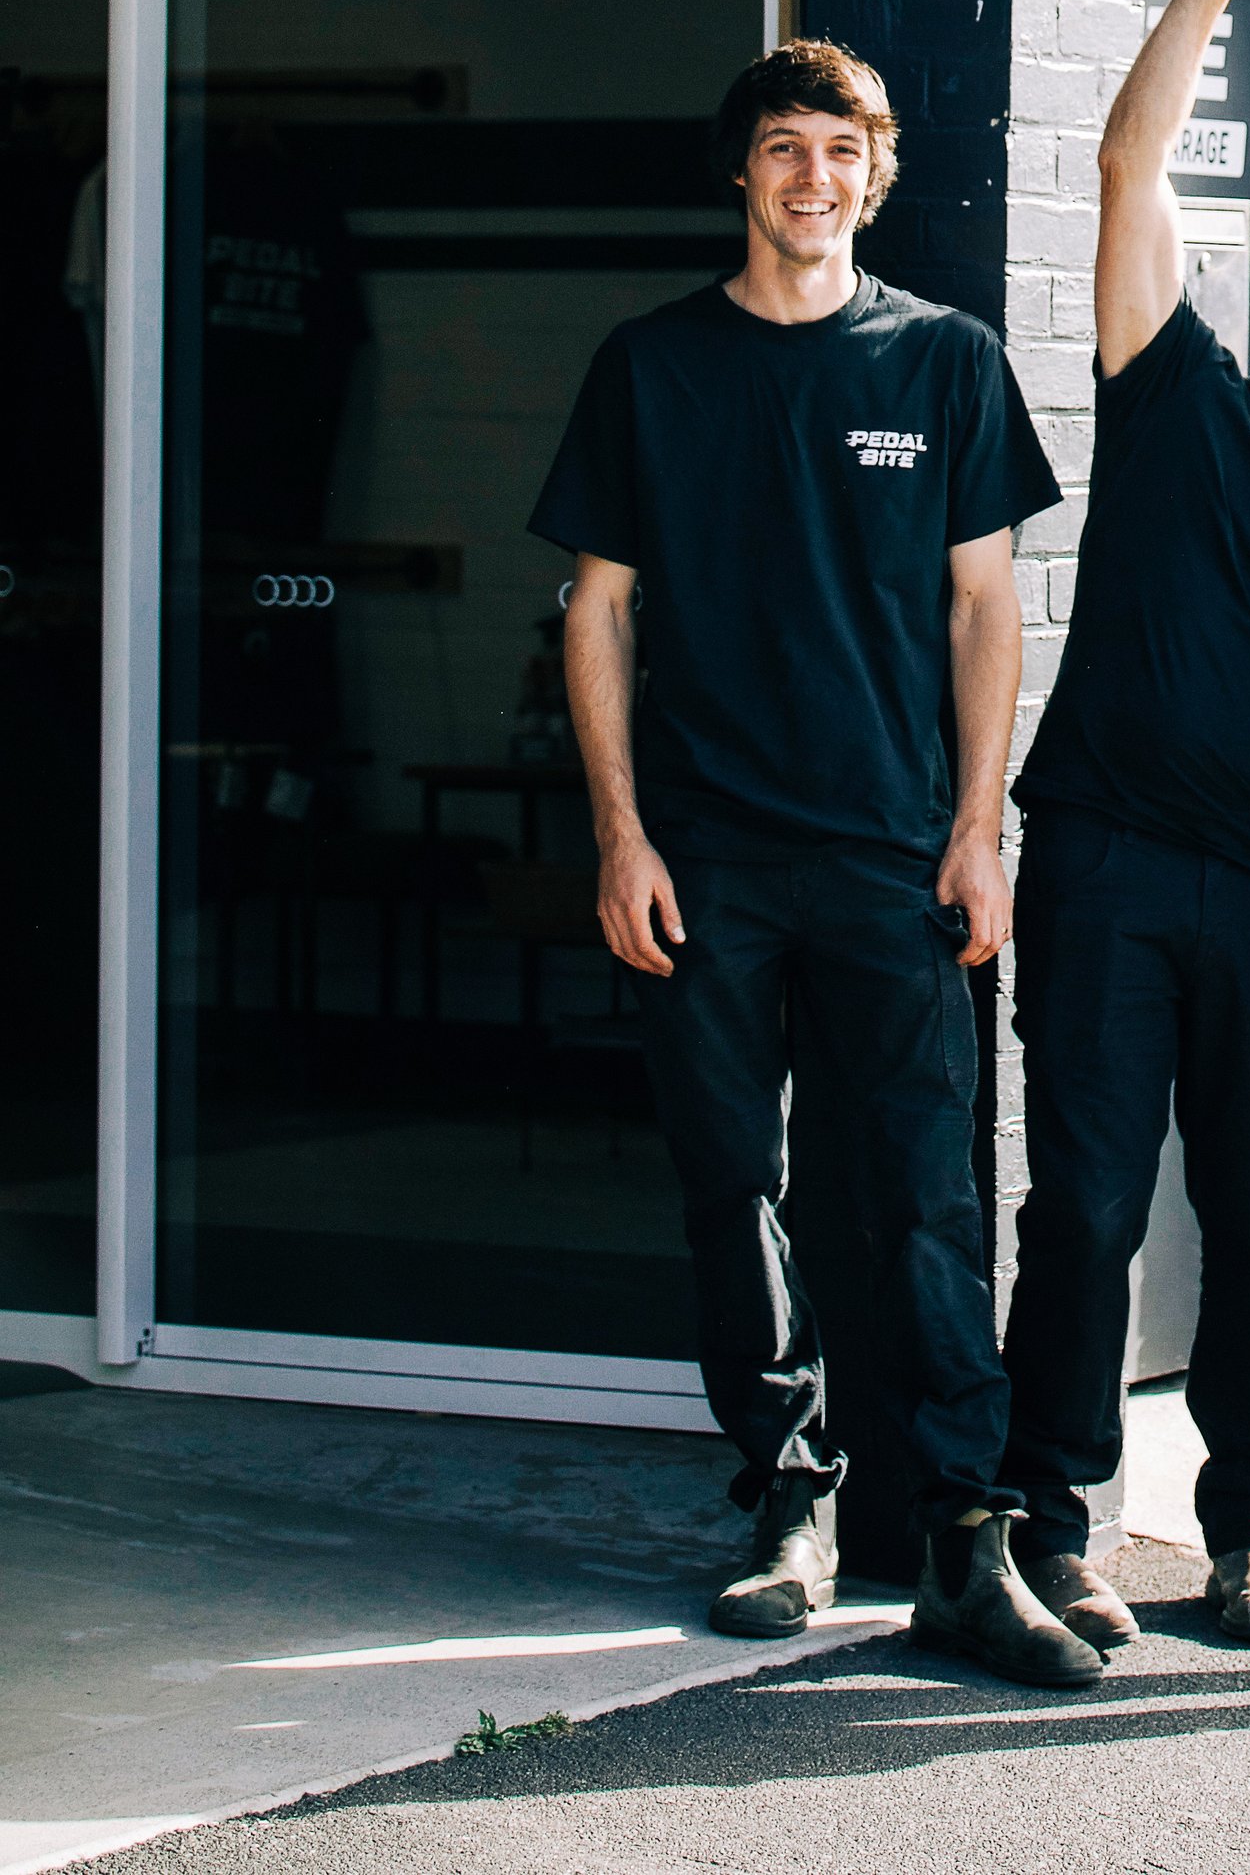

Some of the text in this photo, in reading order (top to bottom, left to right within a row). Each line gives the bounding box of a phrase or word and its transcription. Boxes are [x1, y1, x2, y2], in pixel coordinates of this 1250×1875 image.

[1171, 128, 1230, 165] RAGE
[846, 430, 927, 451] PEDAL
[858, 449, 916, 468] BITE
